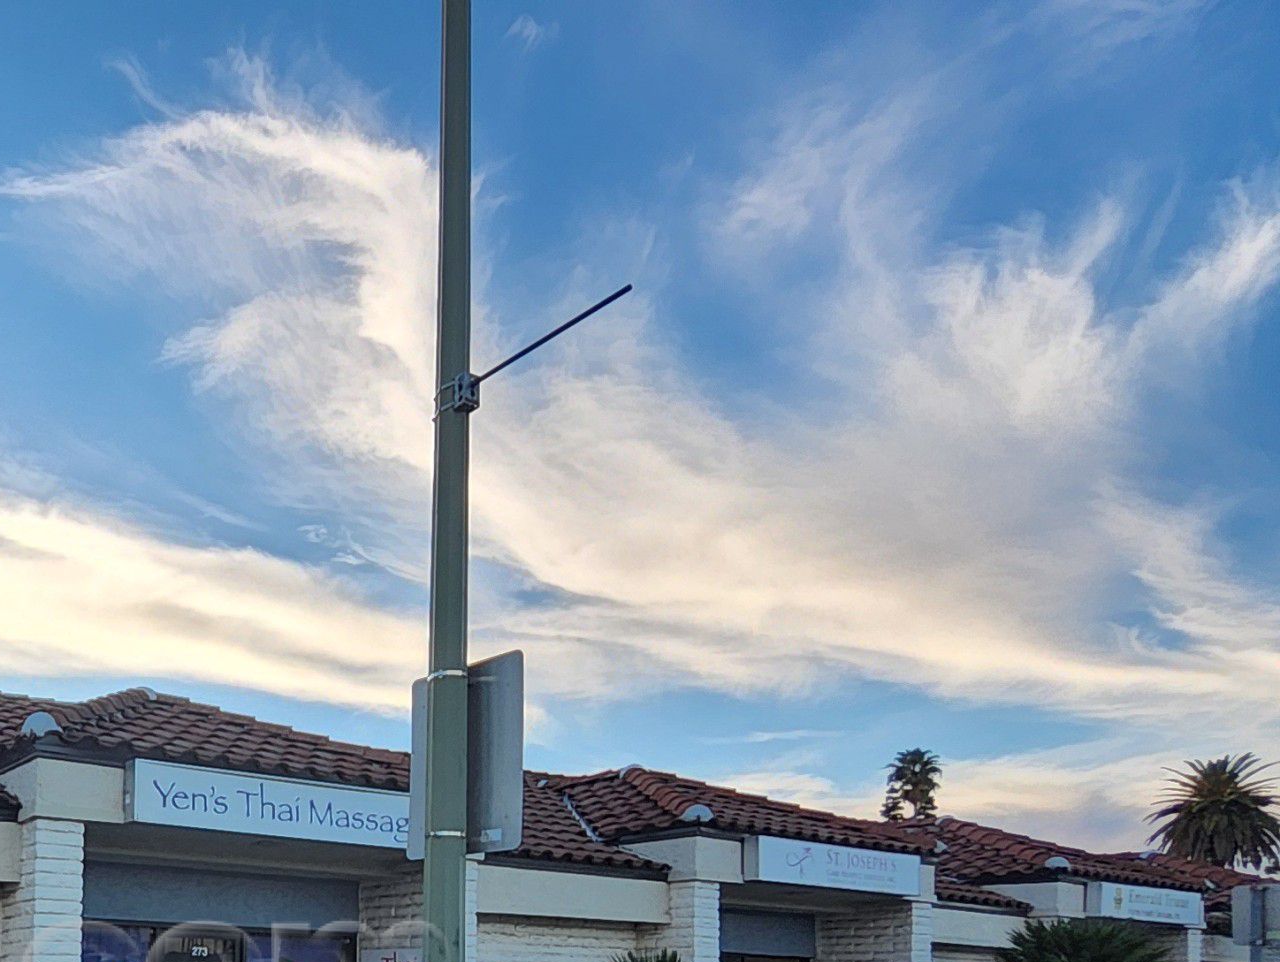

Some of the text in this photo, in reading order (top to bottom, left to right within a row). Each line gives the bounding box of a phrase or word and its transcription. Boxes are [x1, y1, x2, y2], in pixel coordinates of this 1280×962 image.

[152, 779, 410, 844] Yen's Thai Massag
[191, 946, 208, 956] 273
